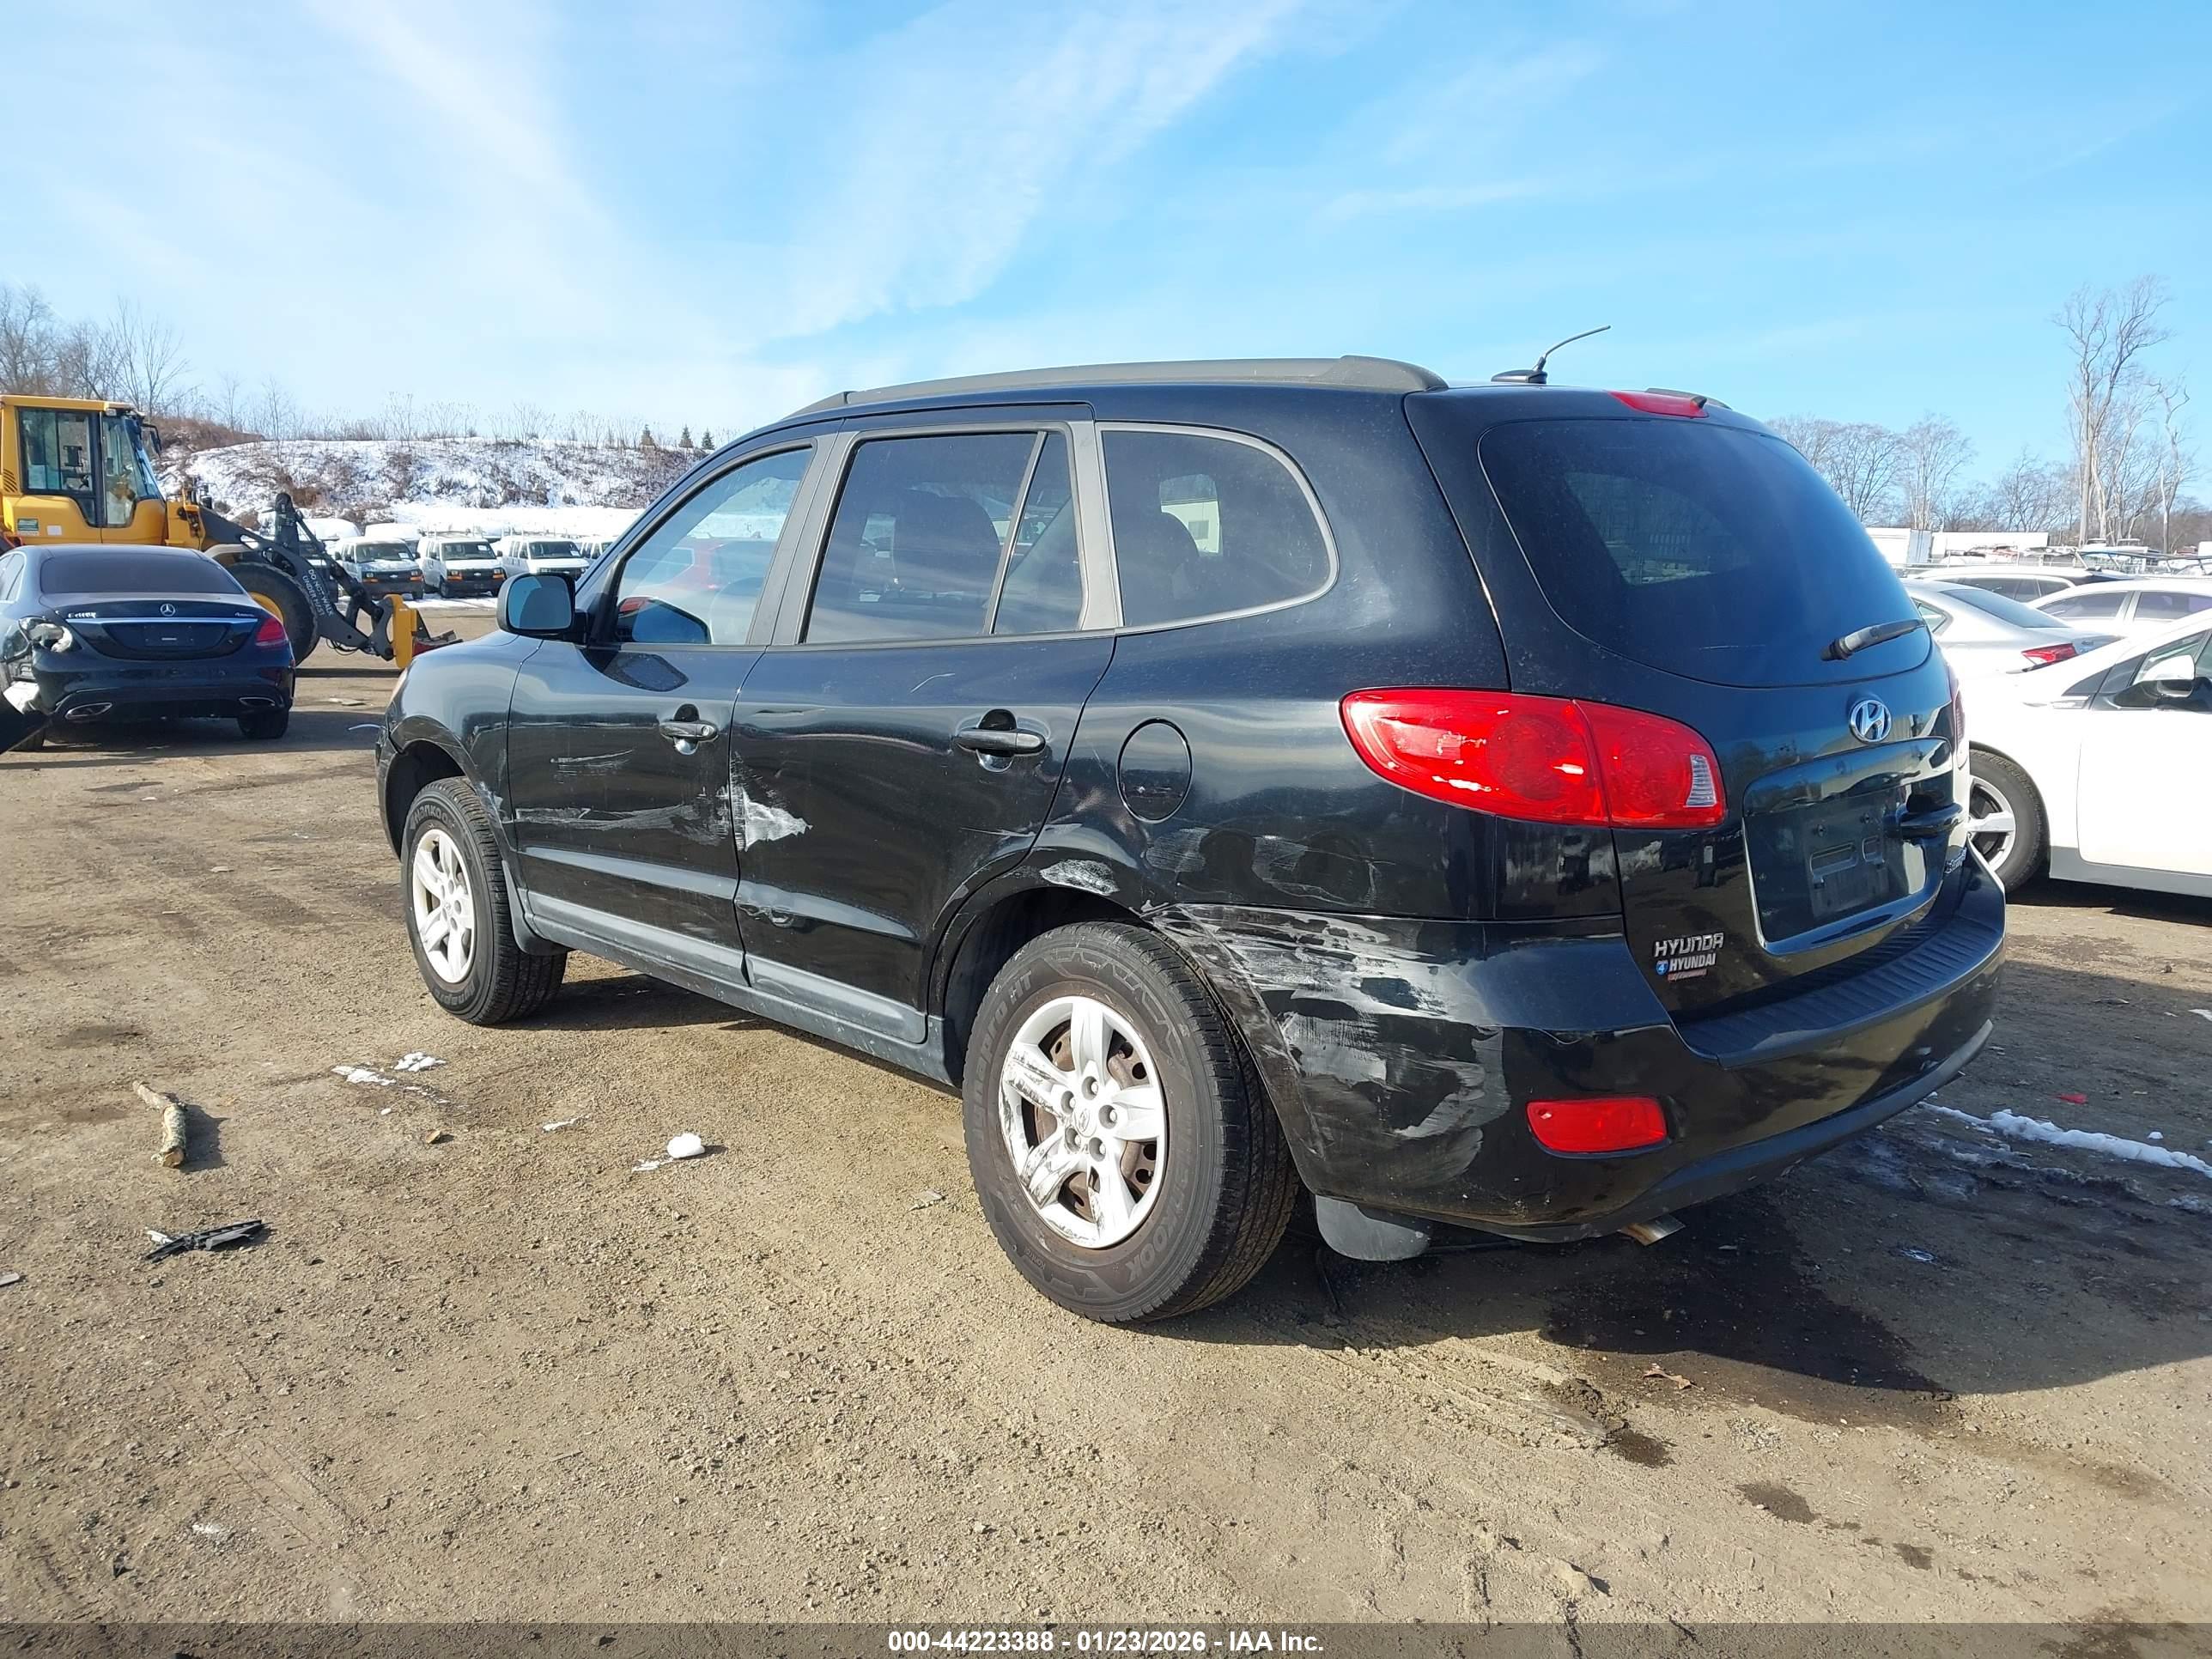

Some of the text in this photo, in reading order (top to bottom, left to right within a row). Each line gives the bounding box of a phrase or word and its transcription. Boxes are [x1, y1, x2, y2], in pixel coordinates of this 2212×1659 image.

[302, 575, 317, 599] UNDER
[308, 569, 335, 616] DO NOT WALK
[1655, 932, 1724, 957] HYUNDA
[1668, 953, 1716, 971] HYUNDAI
[1009, 969, 1033, 1005] HT
